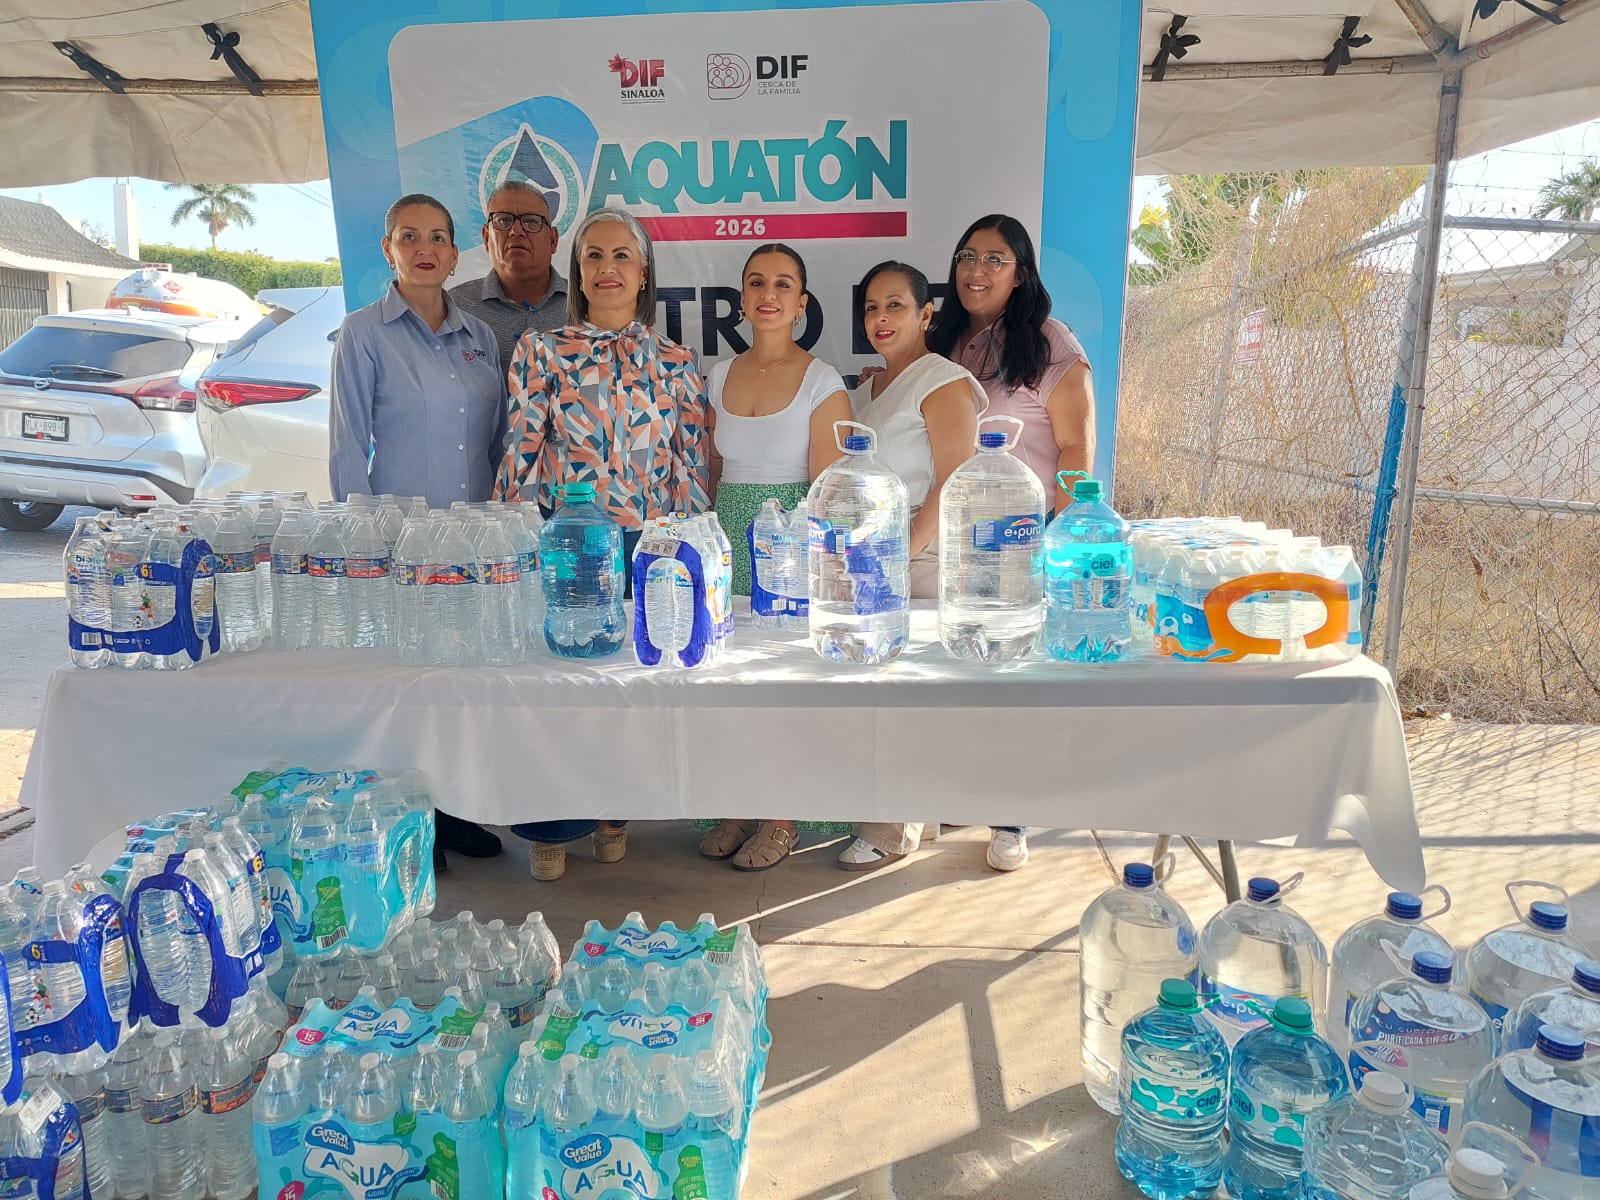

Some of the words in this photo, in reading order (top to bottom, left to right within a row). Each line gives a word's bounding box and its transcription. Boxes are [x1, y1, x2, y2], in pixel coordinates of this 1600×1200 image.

[620, 58, 665, 88] DIF
[756, 54, 808, 80] DIF
[620, 88, 666, 99] SINALOA
[757, 81, 784, 89] CERCA
[769, 88, 801, 97] FAMILIA
[586, 119, 908, 214] AQUATÓN
[714, 218, 766, 236] 2026
[141, 564, 149, 578] 6
[1091, 558, 1115, 570] ciel
[251, 857, 262, 873] 6
[31, 944, 41, 961] 6
[620, 938, 669, 950] AGUA
[343, 1020, 398, 1032] AGUA
[303, 1032, 315, 1042] 15
[1379, 1031, 1424, 1046] PURIFICADA
[1425, 1035, 1440, 1046] SIN
[1196, 1090, 1220, 1108] ciel
[1233, 1090, 1252, 1116] ciel
[311, 1126, 349, 1144] Great
[321, 1133, 350, 1151] Value
[564, 1139, 602, 1158] Great
[574, 1149, 603, 1165] Value
[320, 1152, 395, 1186] AGUA
[574, 1160, 648, 1195] AGUA
